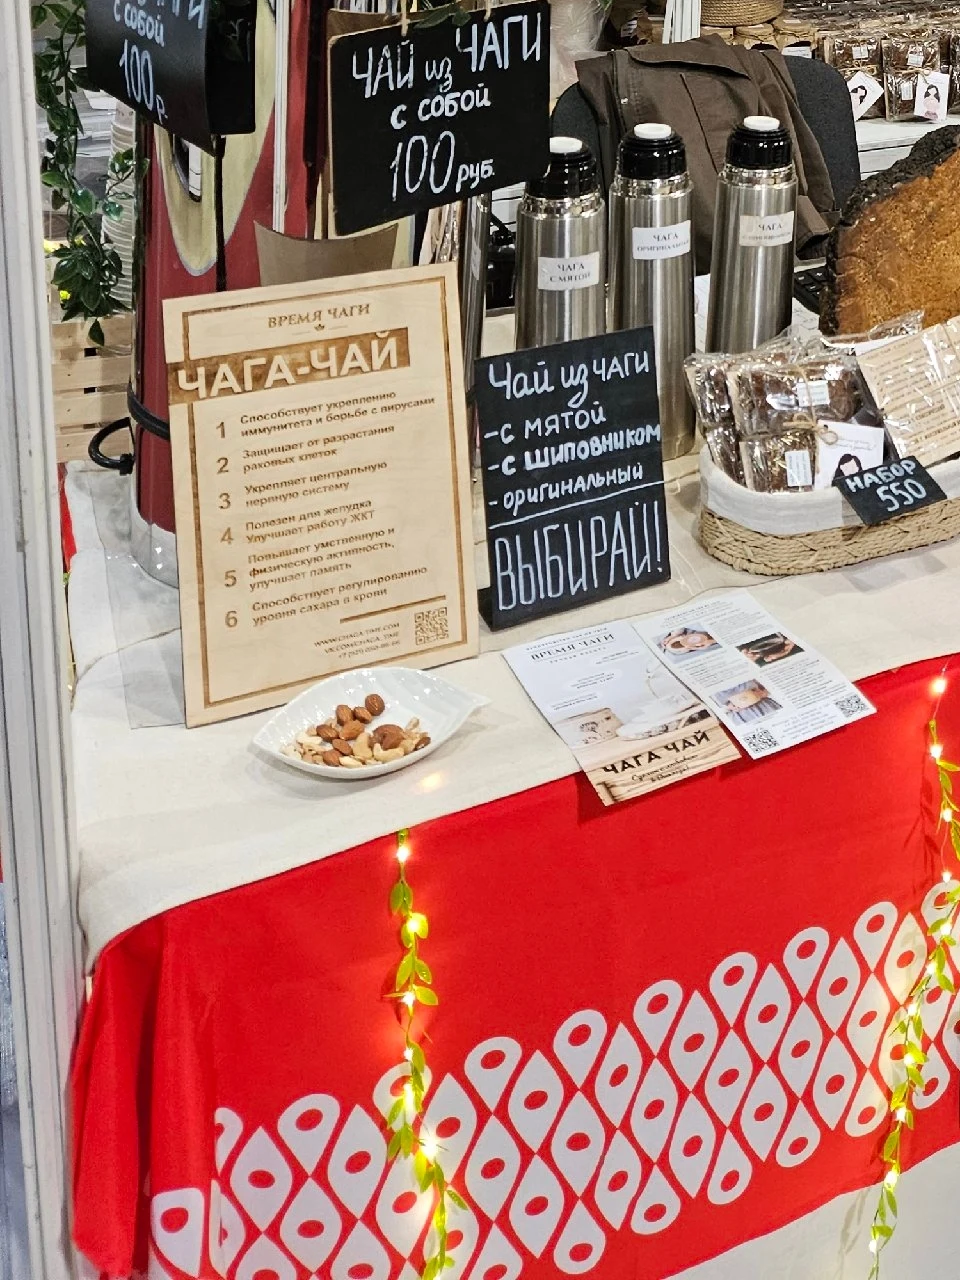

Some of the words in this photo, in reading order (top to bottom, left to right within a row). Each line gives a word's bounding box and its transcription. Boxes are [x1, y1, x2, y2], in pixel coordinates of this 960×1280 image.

[352, 39, 415, 98] ЧАЙ
[425, 57, 453, 92] из
[455, 11, 543, 73] ЧАГИ
[119, 38, 154, 112] 100
[391, 130, 455, 202] 100
[653, 233, 679, 242] ЧАГА
[758, 223, 783, 232] ЧАГА
[557, 262, 585, 272] ЧАГА
[267, 310, 323, 329] ВРЕМЯ
[327, 303, 371, 319] ЧАГИ
[178, 330, 398, 399] ЧАГА-ЧАЙ
[488, 361, 555, 400] Чай
[560, 364, 590, 409] из
[592, 351, 650, 382] ЧАГИ
[215, 421, 227, 439] 1
[240, 404, 323, 425] Способствует
[325, 391, 397, 413] укреплению
[240, 419, 313, 438] иммунитета
[325, 408, 369, 423] борьбе
[380, 397, 435, 415] вирусами
[216, 458, 229, 474] 2
[242, 441, 304, 460] Защищает
[307, 438, 321, 447] от
[323, 424, 395, 445] разрастания
[243, 455, 295, 475] раковых
[298, 447, 338, 463] клеток
[218, 492, 232, 510] 3
[244, 477, 306, 496] Укрепляет
[308, 460, 388, 484] центральную
[245, 490, 299, 508] нервную
[302, 481, 350, 498] систему
[846, 458, 917, 493] НАБОР
[877, 479, 927, 512] 550
[220, 527, 234, 546] 4
[245, 512, 297, 532] Полезен
[299, 508, 321, 522] для
[324, 499, 372, 518] желудка
[246, 524, 304, 545] Улучшает
[307, 516, 348, 534] работу
[350, 509, 376, 524] ЖКТ
[248, 544, 311, 565] Повышает
[313, 531, 385, 553] умственную
[494, 500, 663, 611] ВЫБИРАЙ!
[224, 570, 237, 588] 5
[249, 555, 324, 579] физическую
[249, 572, 307, 593] улучшает
[310, 562, 352, 578] память
[224, 610, 238, 628] 6
[252, 587, 336, 612] Способствует
[338, 566, 428, 593] регулированию
[252, 608, 297, 628] уровня
[299, 598, 341, 615] сахара
[353, 588, 388, 605] крови
[531, 643, 576, 661] ВРЕМЯ
[578, 632, 615, 648] ЧАГИ
[601, 750, 662, 775] ЧАГА
[663, 729, 711, 754] ЧАЙ
